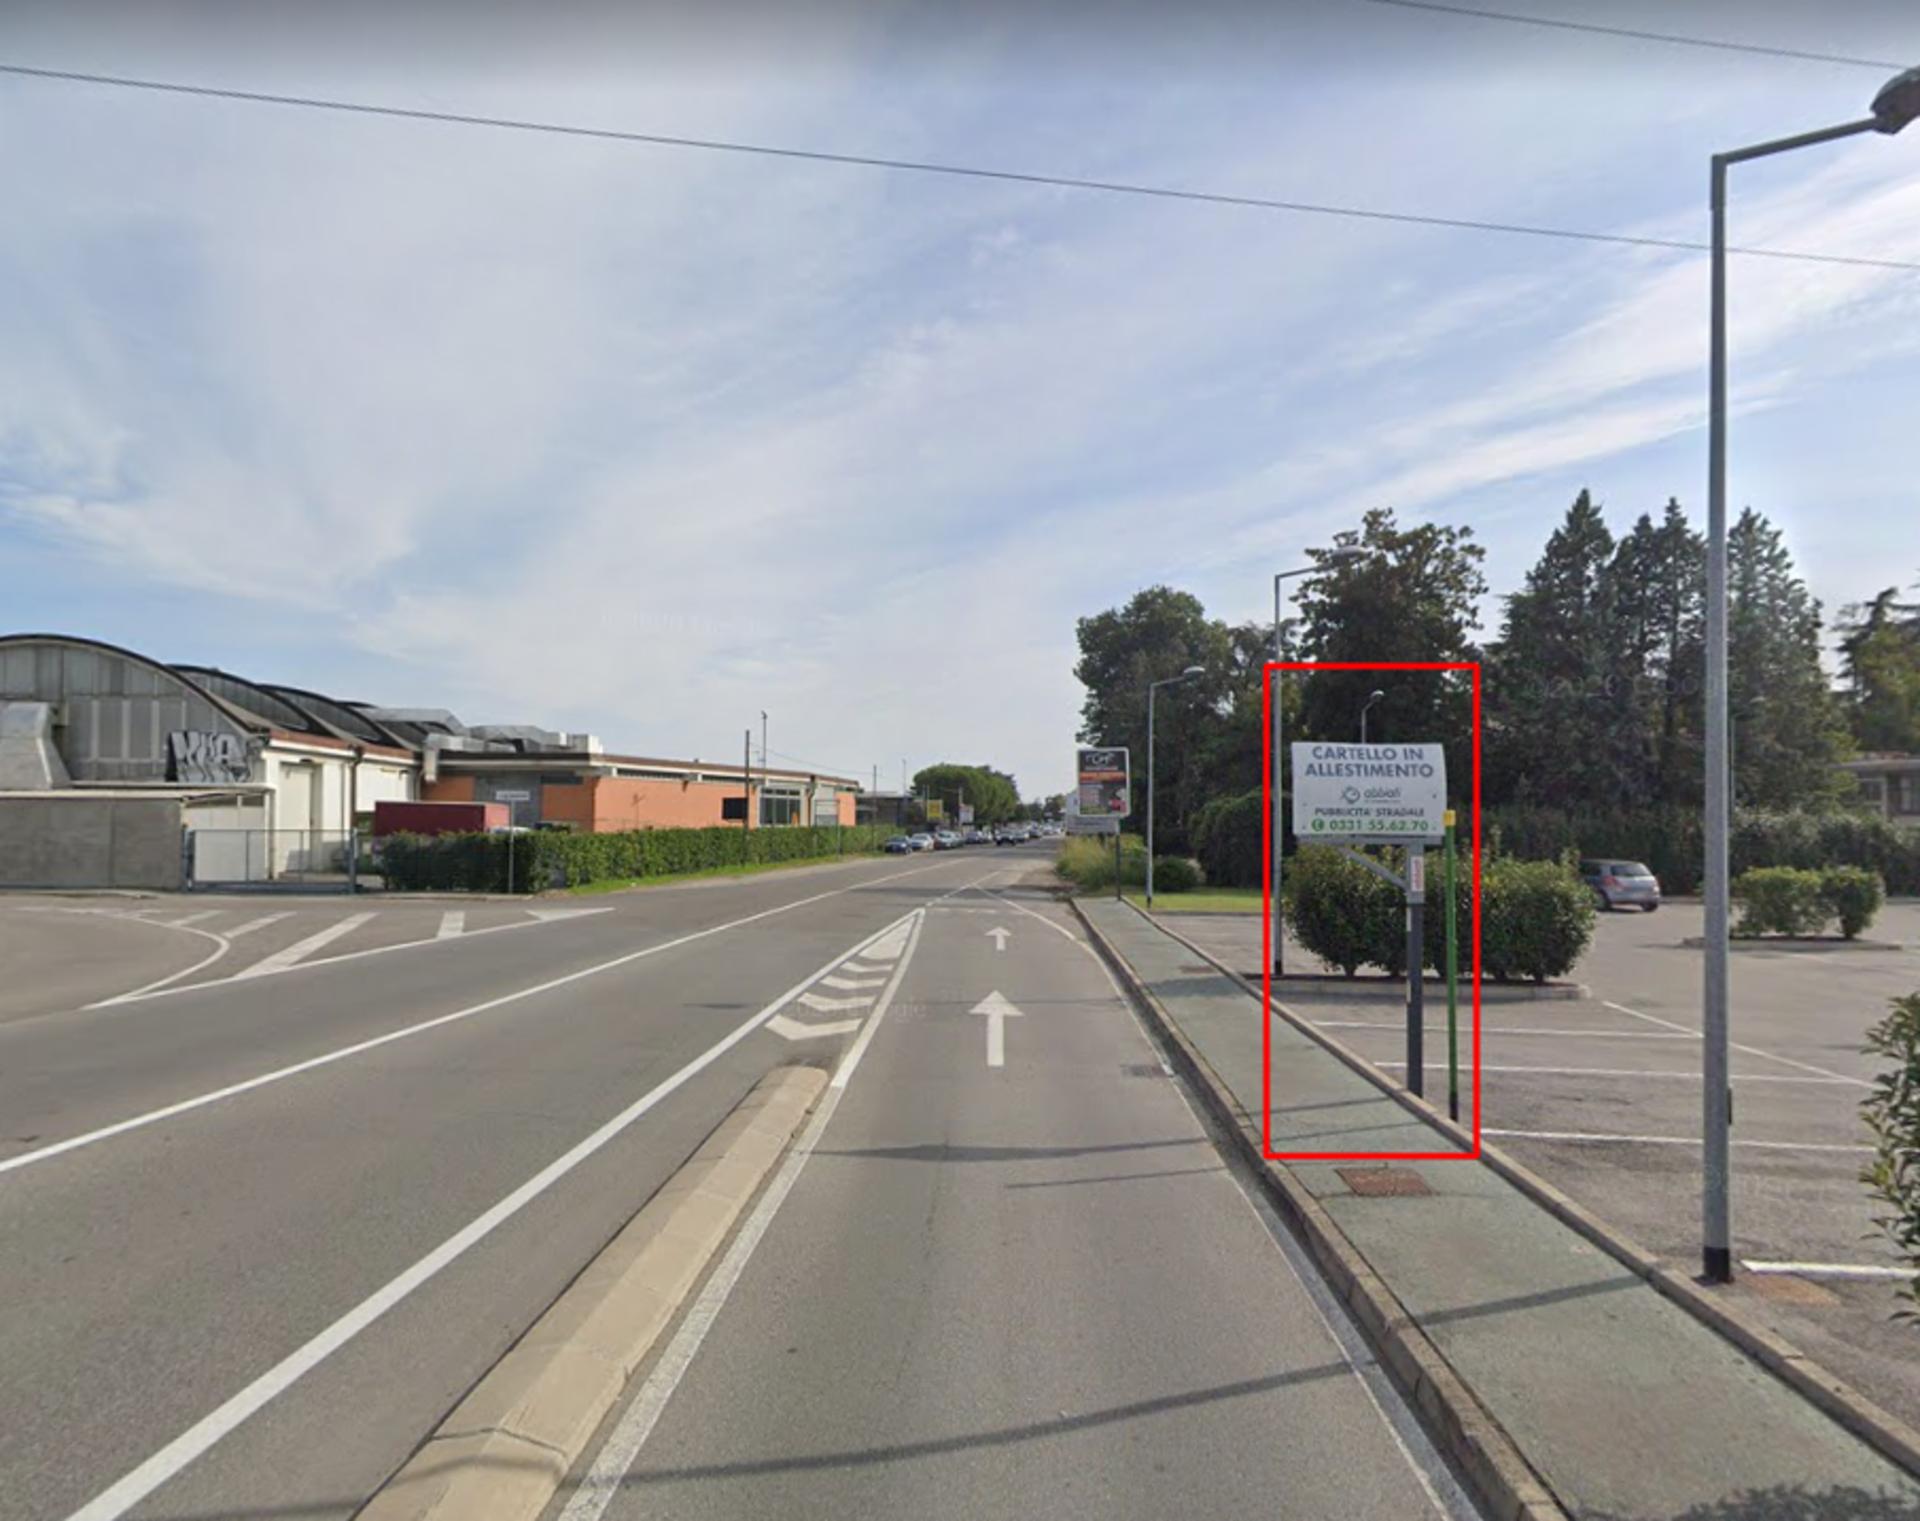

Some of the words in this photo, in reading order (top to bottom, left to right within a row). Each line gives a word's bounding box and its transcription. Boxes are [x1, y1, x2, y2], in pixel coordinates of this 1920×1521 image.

[1312, 746, 1397, 760] CARTELLO
[1404, 748, 1424, 760] IN
[1305, 763, 1434, 778] ALLESTIMENTO
[1375, 807, 1425, 817] STRADALE
[1329, 820, 1362, 831] 0331
